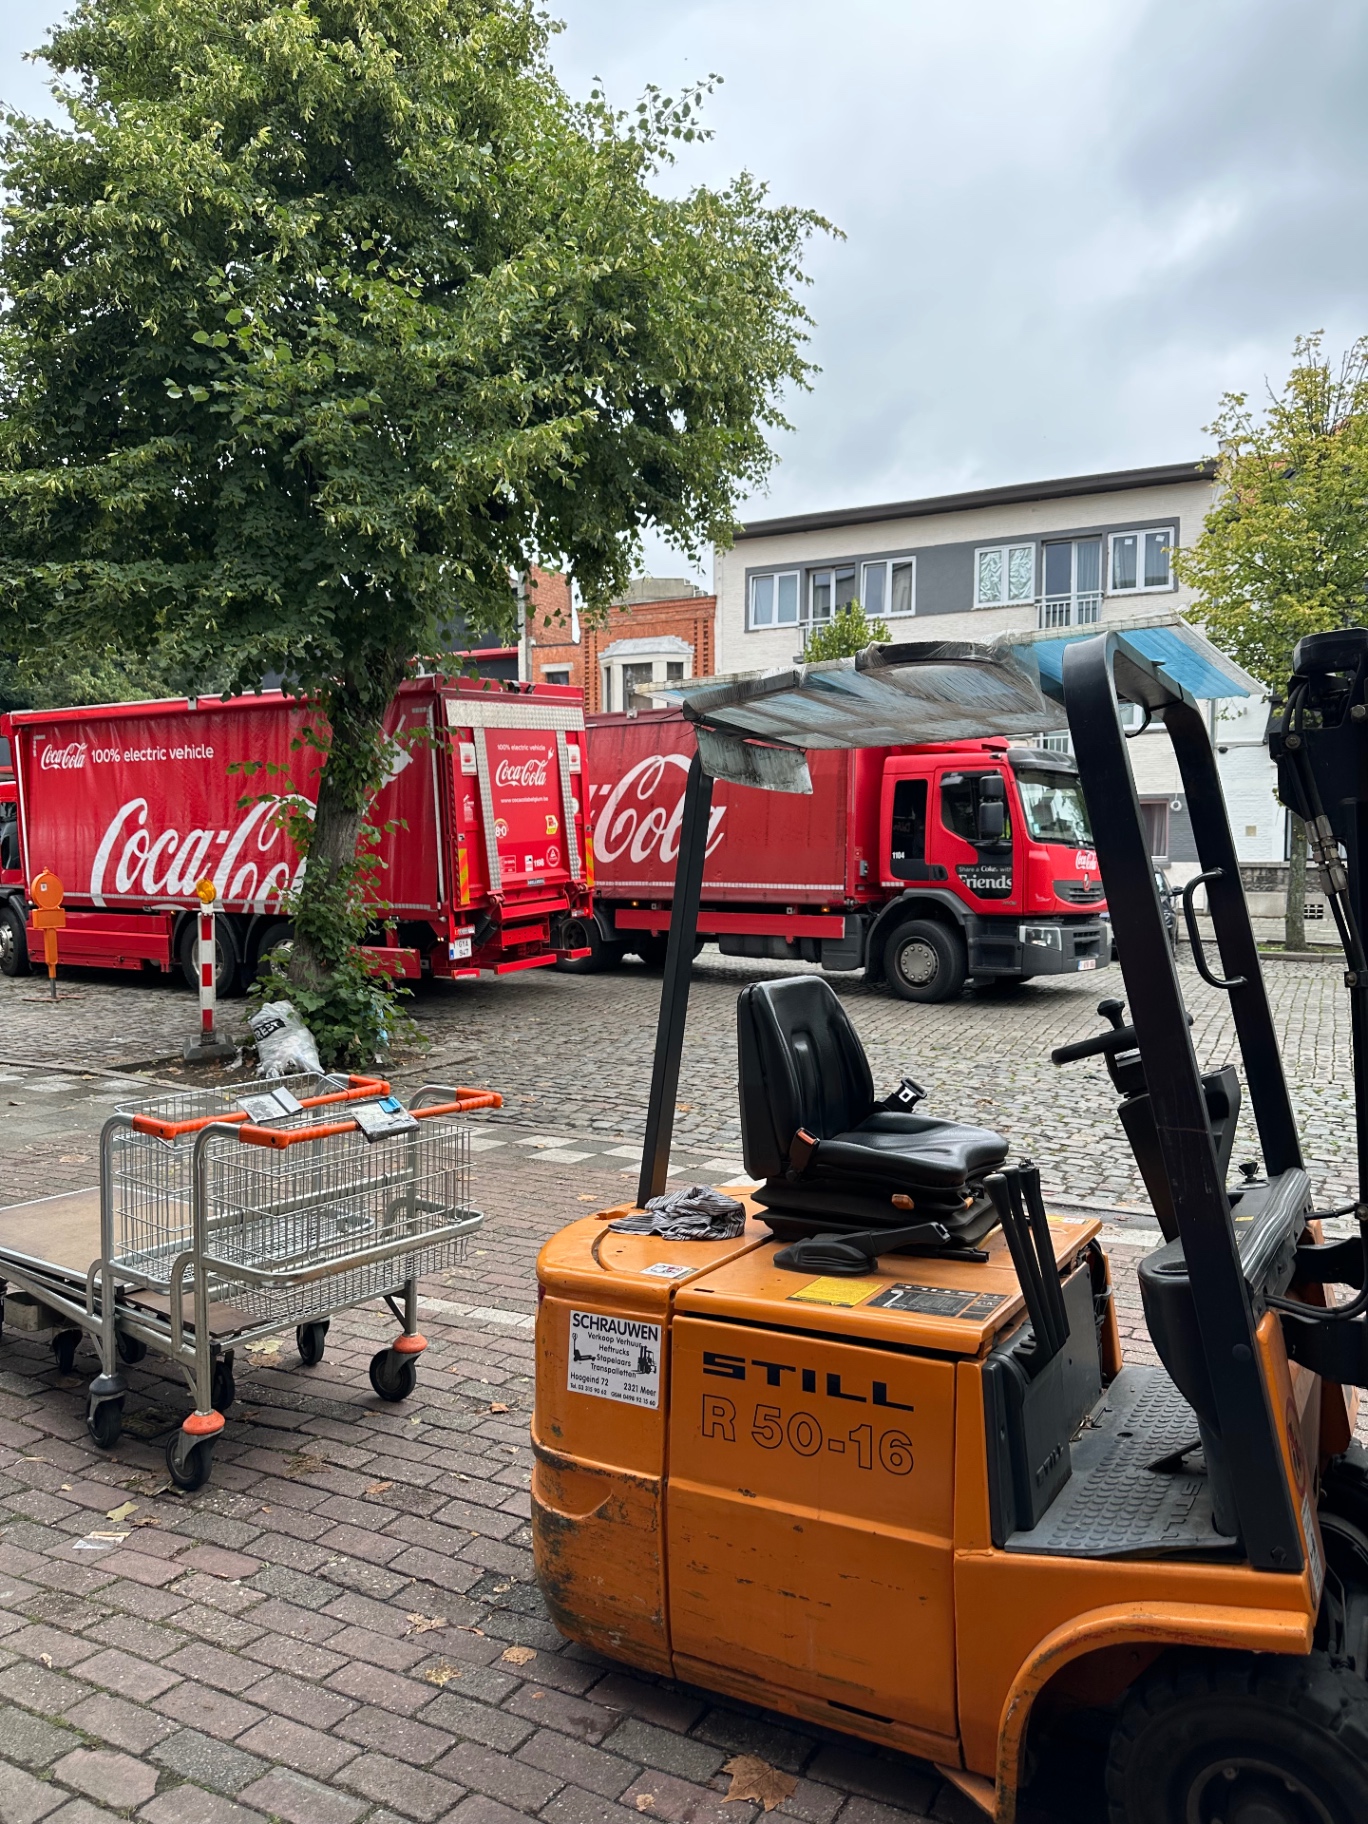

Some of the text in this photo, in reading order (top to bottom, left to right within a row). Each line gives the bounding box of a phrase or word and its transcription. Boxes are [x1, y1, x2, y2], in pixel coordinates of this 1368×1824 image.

[91, 744, 214, 763] 100% electric vehicle
[892, 851, 905, 859] 1104
[255, 1021, 280, 1039] REST
[573, 1313, 658, 1341] SCHRAUWEN
[588, 1332, 641, 1348] Verkoop Verhuur
[599, 1344, 630, 1356] Heftrucks
[596, 1354, 631, 1367] Stapelaars
[591, 1363, 636, 1378] Transpalletten
[571, 1372, 657, 1397] Hoogeind 72 2321 Meer
[703, 1351, 914, 1412] STILL
[702, 1393, 914, 1475] R 50-16
